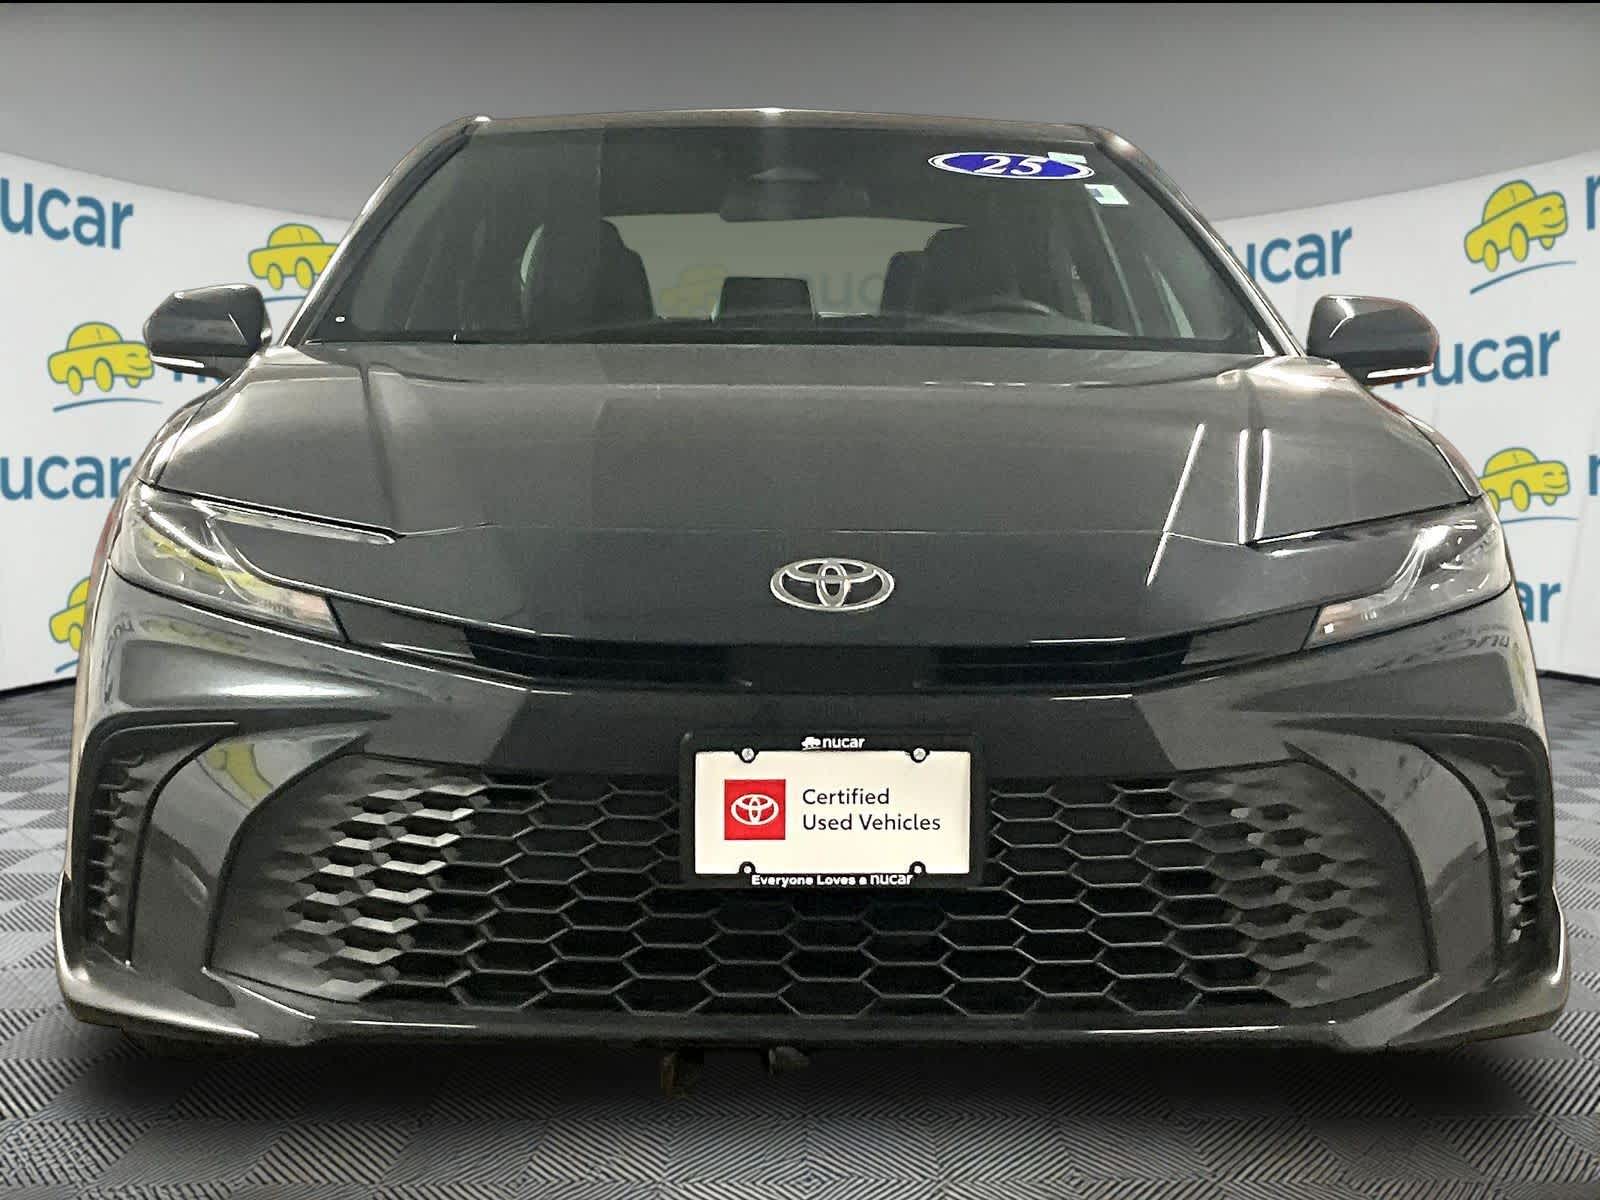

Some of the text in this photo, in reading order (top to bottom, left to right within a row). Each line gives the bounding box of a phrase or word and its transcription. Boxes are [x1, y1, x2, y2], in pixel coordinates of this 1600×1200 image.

[974, 155, 1050, 176] 25
[1394, 330, 1560, 389] ucar
[822, 737, 865, 748] nucar
[802, 787, 890, 805] Certified
[803, 813, 941, 831] Used Vehicles
[751, 874, 914, 888] Everyone Loves a nucar
